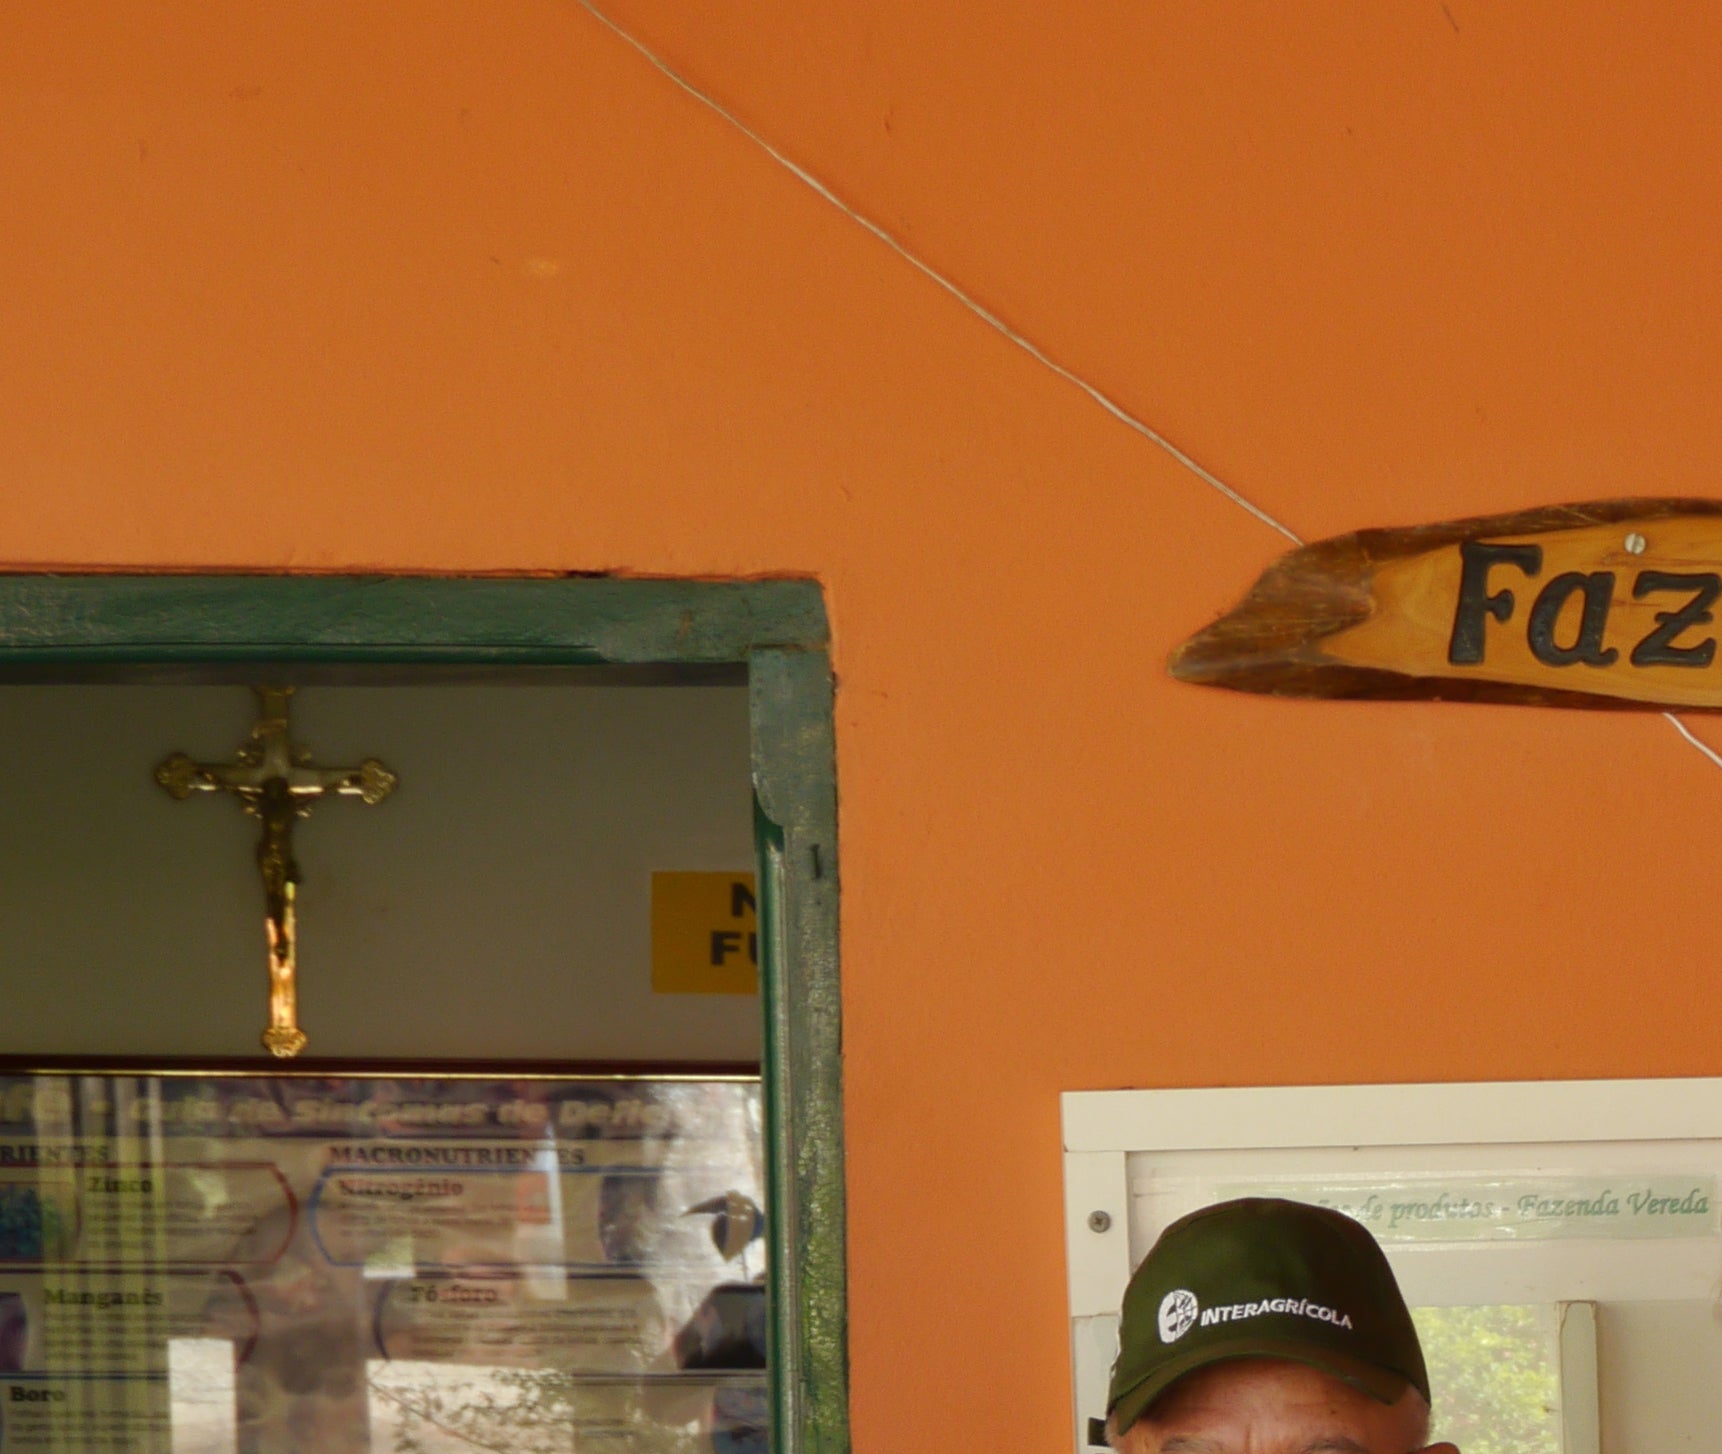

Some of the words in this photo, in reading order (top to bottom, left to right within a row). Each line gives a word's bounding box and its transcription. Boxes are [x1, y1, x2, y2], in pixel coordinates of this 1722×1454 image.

[329, 1146, 586, 1165] MACRONUTRIENES
[1388, 1192, 1494, 1229] produtos
[1517, 1190, 1620, 1217] Fazenda
[1626, 1187, 1709, 1216] Vereda
[1201, 1298, 1354, 1330] INTERAGRÍCOLA
